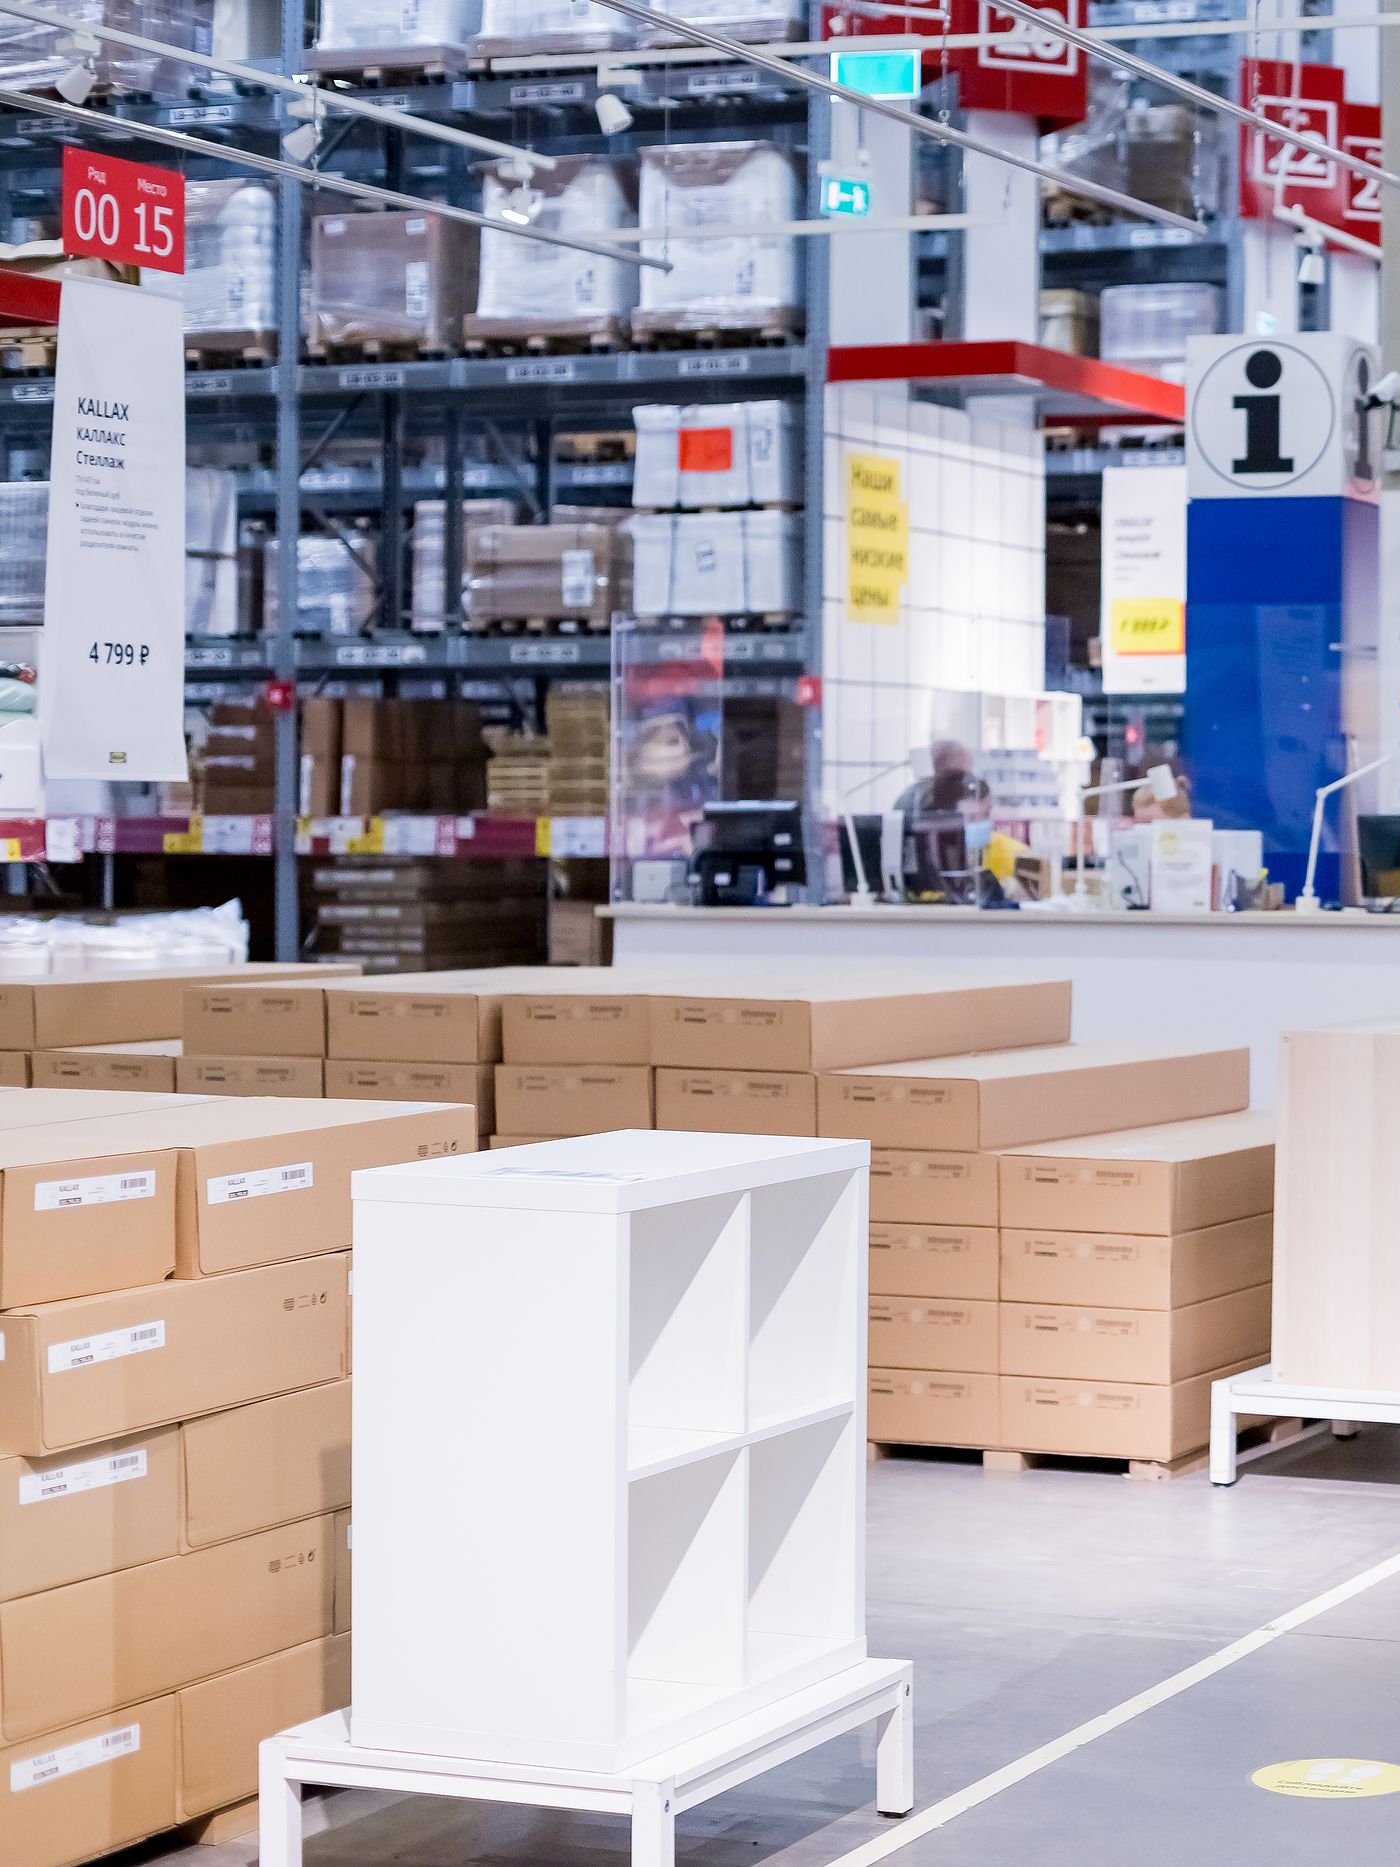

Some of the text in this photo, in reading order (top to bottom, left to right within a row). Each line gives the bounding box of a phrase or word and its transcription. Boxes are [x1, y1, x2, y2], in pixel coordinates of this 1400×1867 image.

[88, 166, 167, 198] Ряд Место
[75, 189, 173, 257] 00 15
[78, 397, 129, 421] KALLAX
[76, 427, 126, 446] КАЛЛАКС
[76, 450, 125, 469] Стеллаж
[852, 463, 893, 491] Наши
[89, 642, 99, 663] 4
[104, 643, 133, 665] 799
